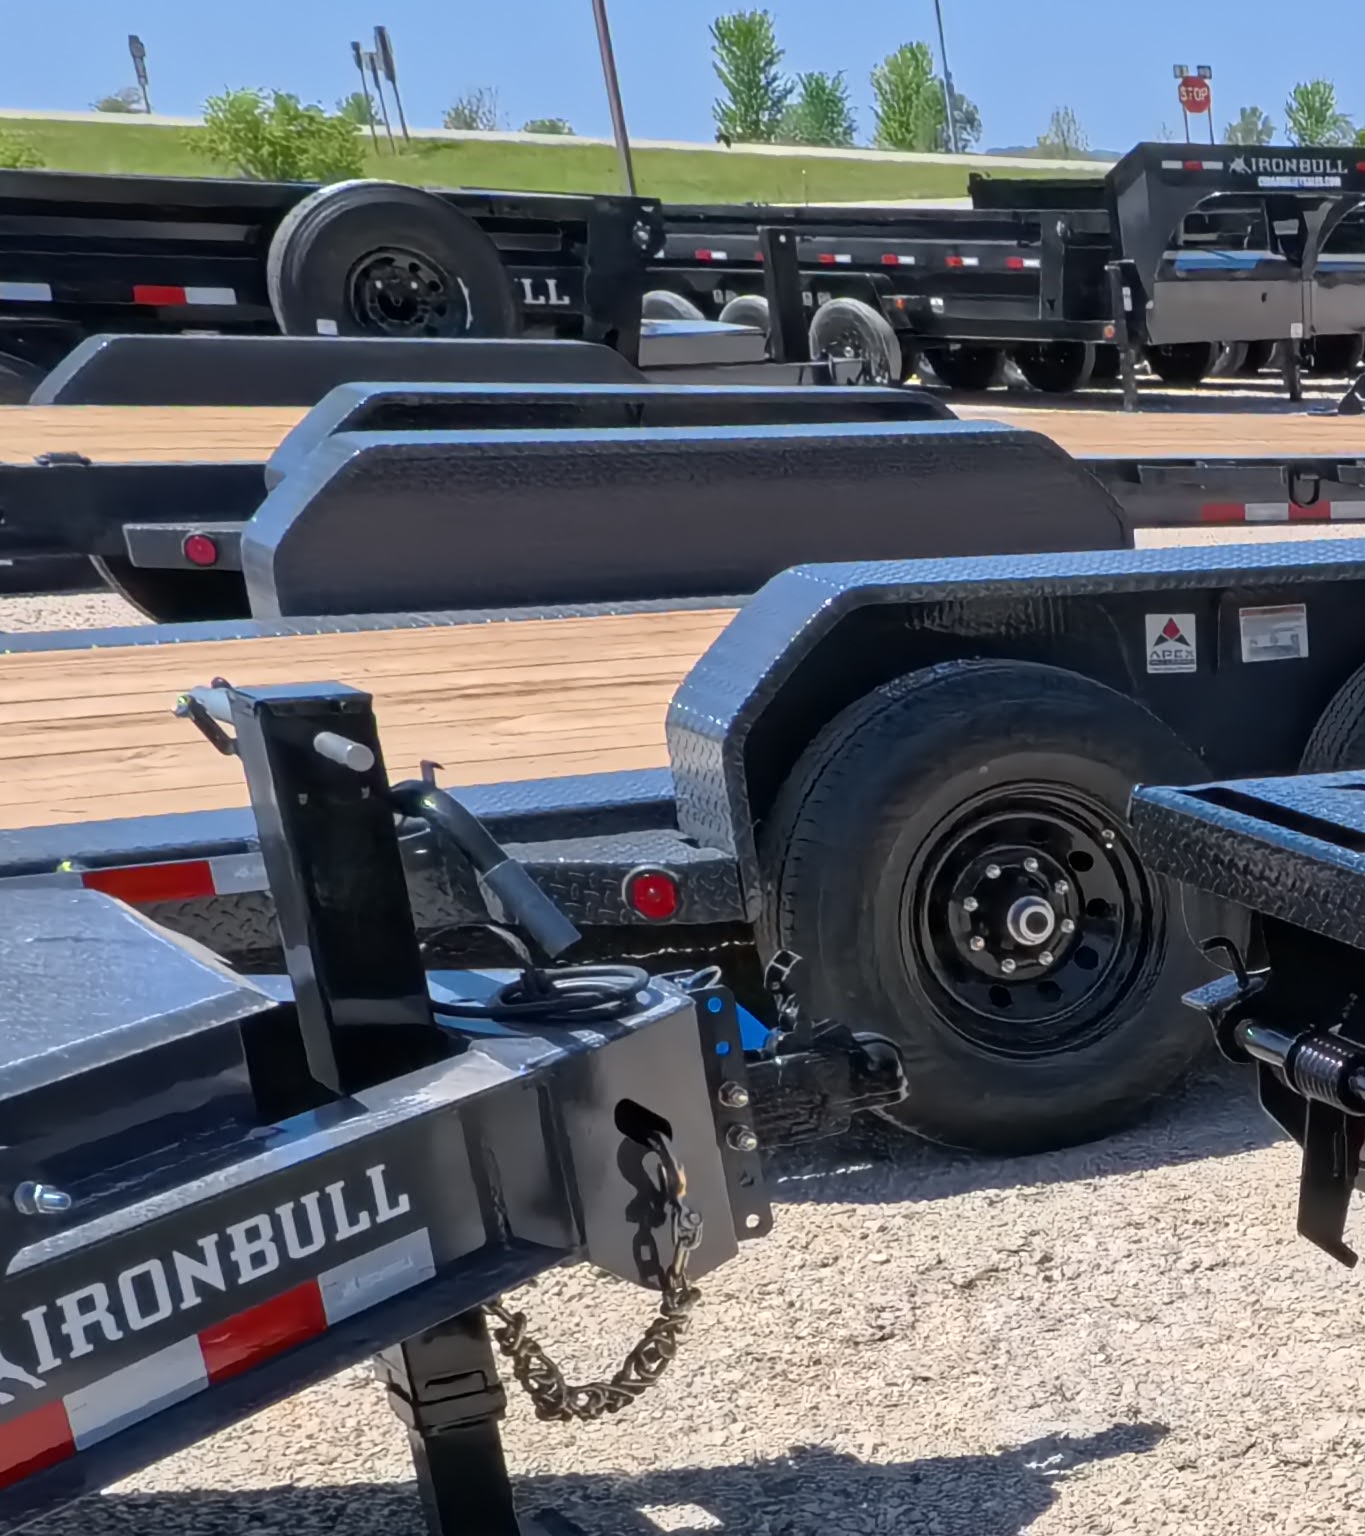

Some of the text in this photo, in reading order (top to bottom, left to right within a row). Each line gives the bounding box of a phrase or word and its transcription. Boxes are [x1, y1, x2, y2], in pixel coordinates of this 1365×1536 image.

[1180, 86, 1208, 101] STOP
[1251, 158, 1348, 174] IRONBULL
[1150, 650, 1195, 659] APEX
[22, 1164, 411, 1374] IRONBULL
